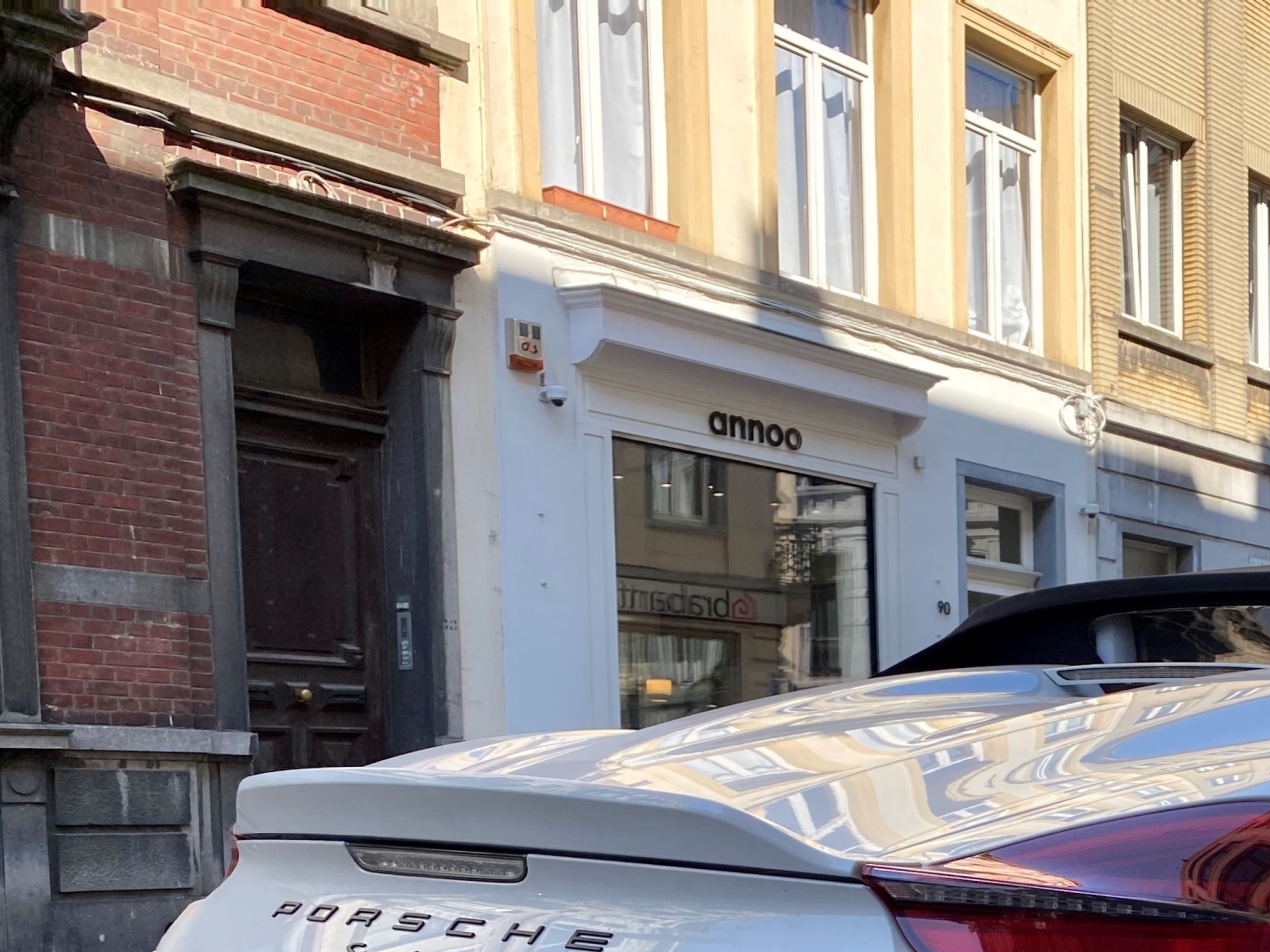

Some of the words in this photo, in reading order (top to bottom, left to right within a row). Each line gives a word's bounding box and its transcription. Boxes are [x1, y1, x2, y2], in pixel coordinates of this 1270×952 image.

[708, 410, 802, 451] annoo
[937, 600, 951, 616] 90
[271, 900, 614, 952] PORSCHE
